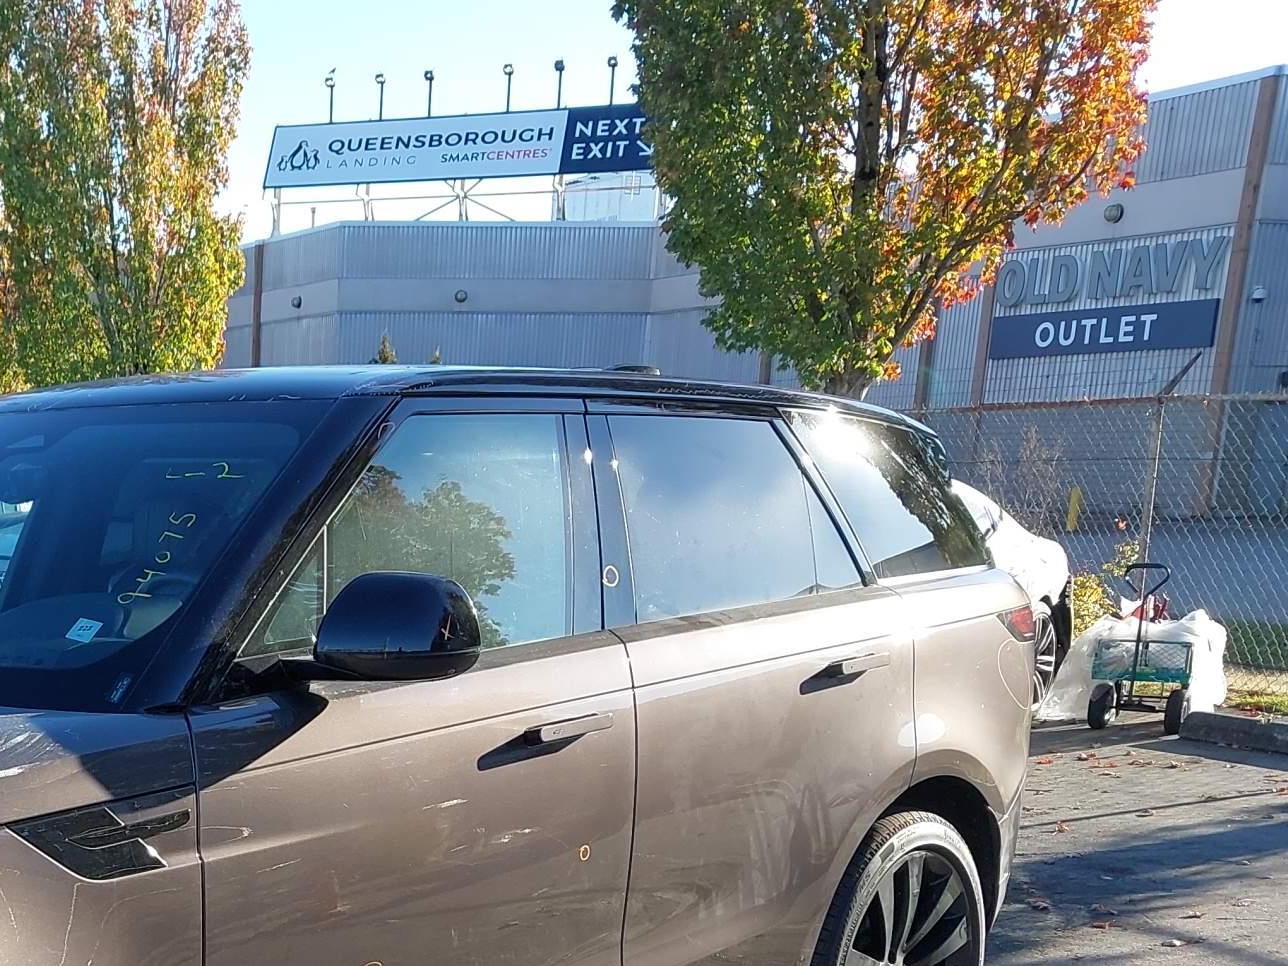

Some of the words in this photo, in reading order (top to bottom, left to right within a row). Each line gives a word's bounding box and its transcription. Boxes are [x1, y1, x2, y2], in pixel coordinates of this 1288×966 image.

[575, 117, 646, 138] NEXT
[328, 127, 554, 155] QUEENSBOROUGH
[571, 140, 630, 160] EXIT
[326, 155, 416, 169] LANDING
[440, 148, 549, 163] SMARTCENTRES
[995, 253, 1079, 307] OLD
[1087, 235, 1230, 300] NAVY
[1034, 313, 1158, 348] OUTLET
